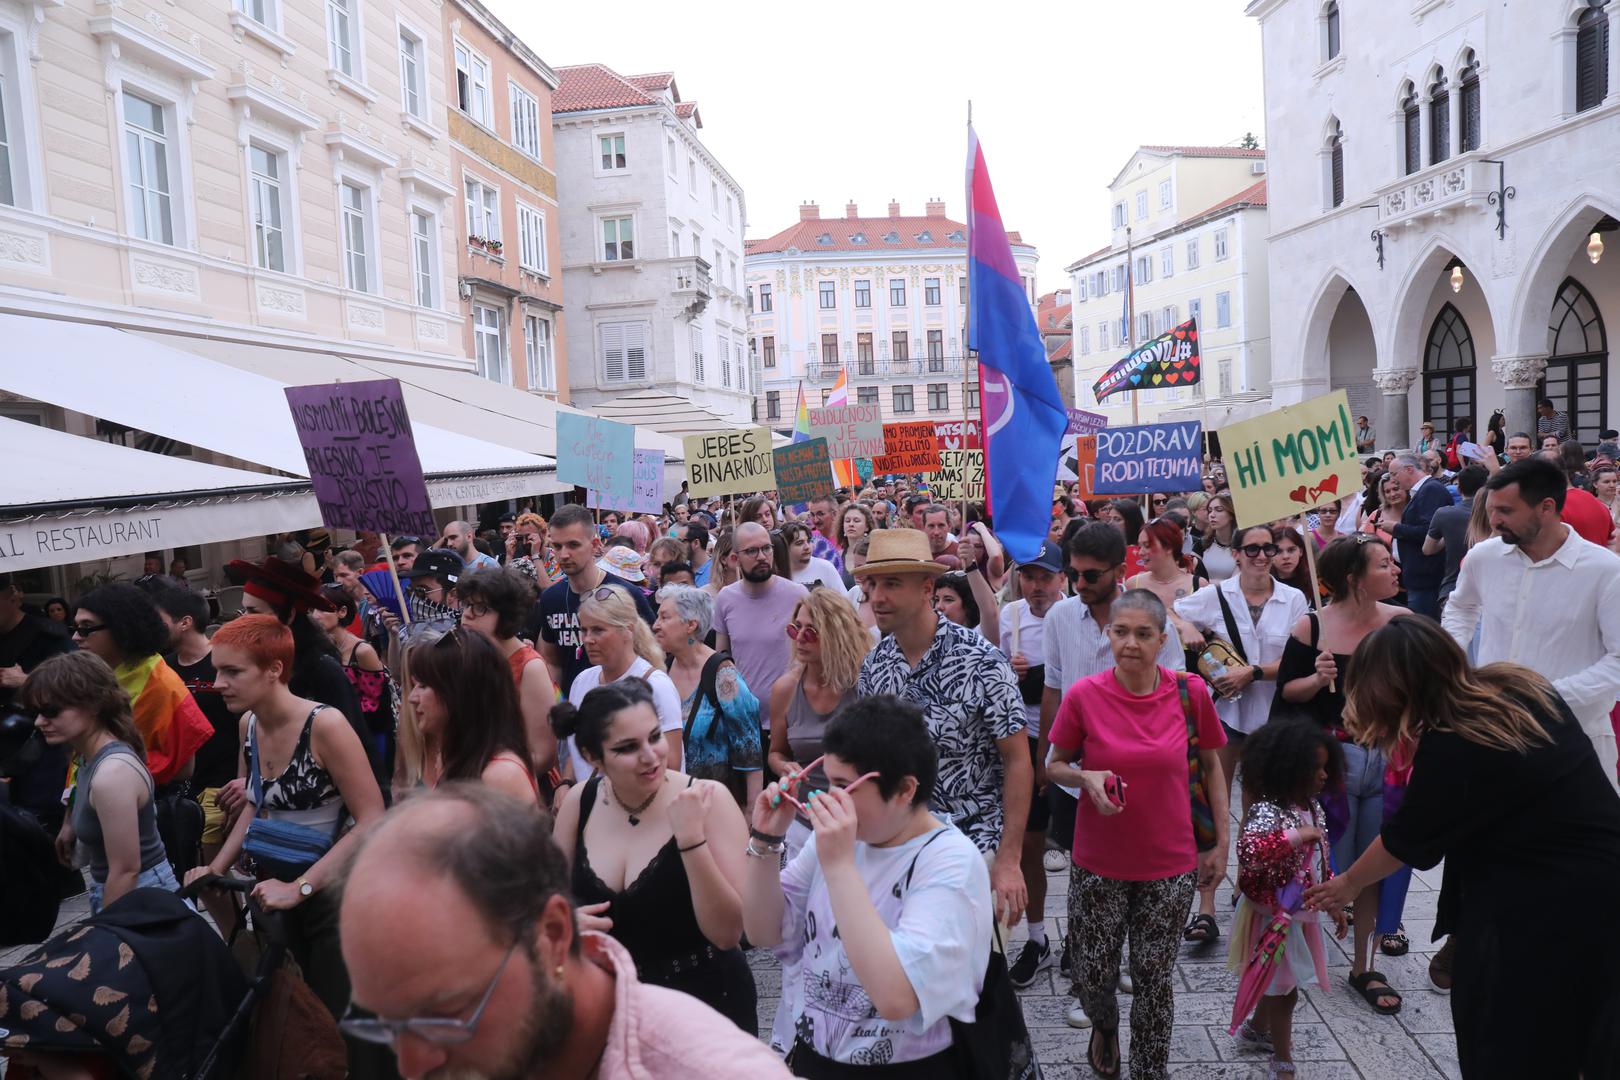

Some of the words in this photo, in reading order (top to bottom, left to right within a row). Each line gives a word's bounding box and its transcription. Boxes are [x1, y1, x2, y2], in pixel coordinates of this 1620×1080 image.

[292, 403, 334, 432] NISMO
[837, 424, 857, 441] JE
[697, 430, 756, 459] JEBEŠ
[1096, 425, 1199, 458] POZDRAV
[1272, 404, 1356, 477] MOM!
[303, 446, 365, 478] BOLESNO
[366, 445, 395, 476] JE
[691, 452, 772, 484] BINARNOST
[930, 468, 962, 482] DANAS
[1101, 457, 1199, 483] RODITELJIMA
[36, 518, 161, 553] RESTAURANT
